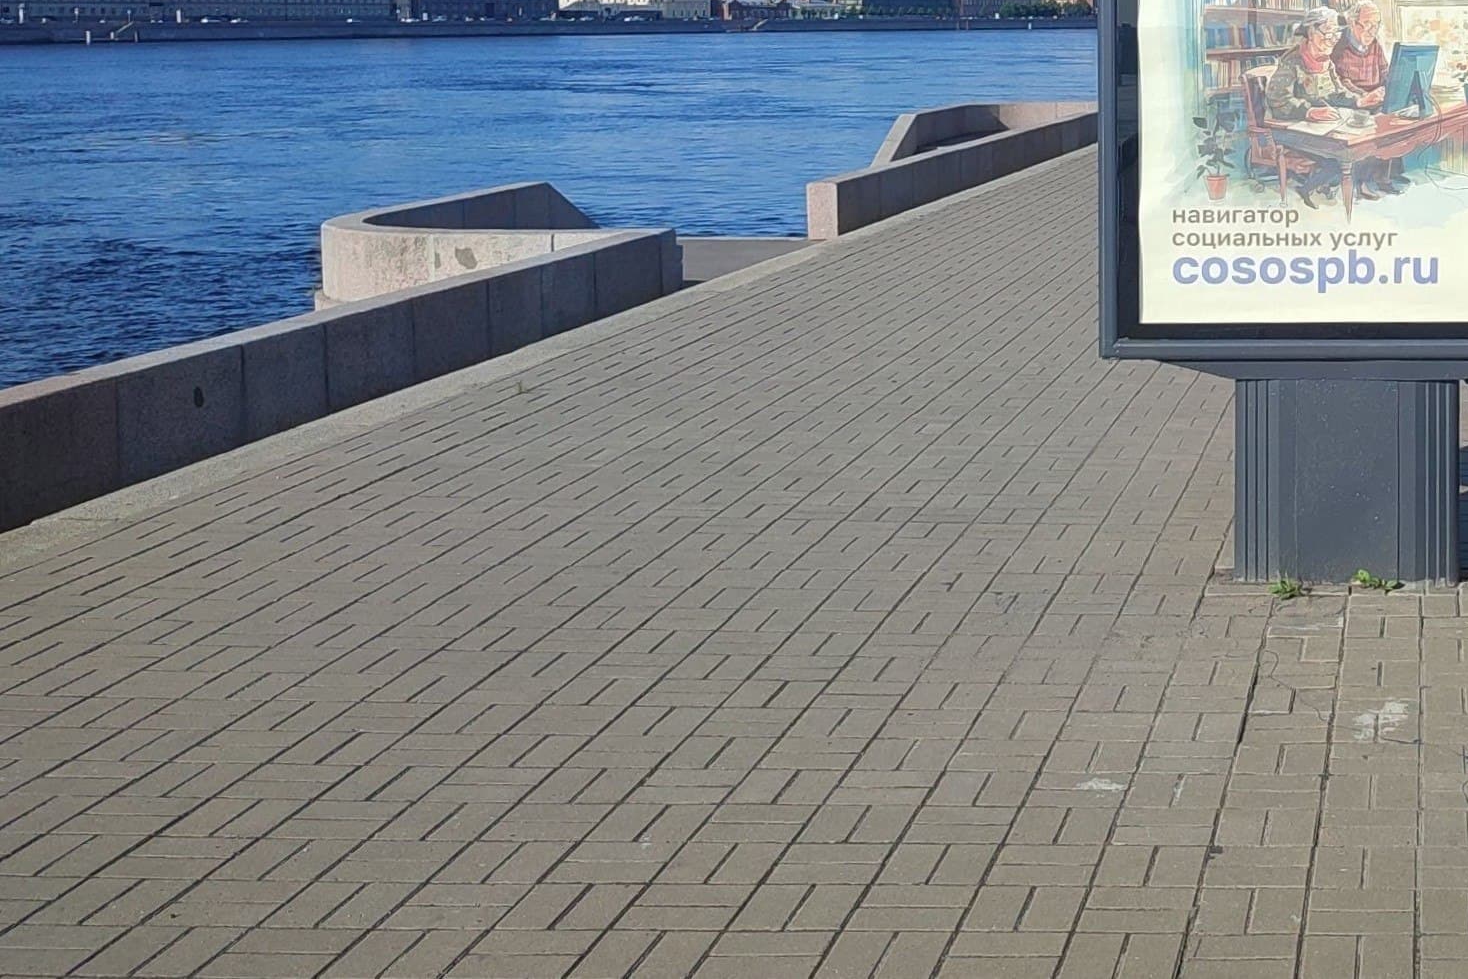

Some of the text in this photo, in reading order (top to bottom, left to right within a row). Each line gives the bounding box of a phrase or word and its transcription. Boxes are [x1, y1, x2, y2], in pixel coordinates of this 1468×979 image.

[1172, 208, 1300, 226] навигатор
[1172, 229, 1399, 251] социальных услуг
[1172, 249, 1439, 294] cosospb.ru
